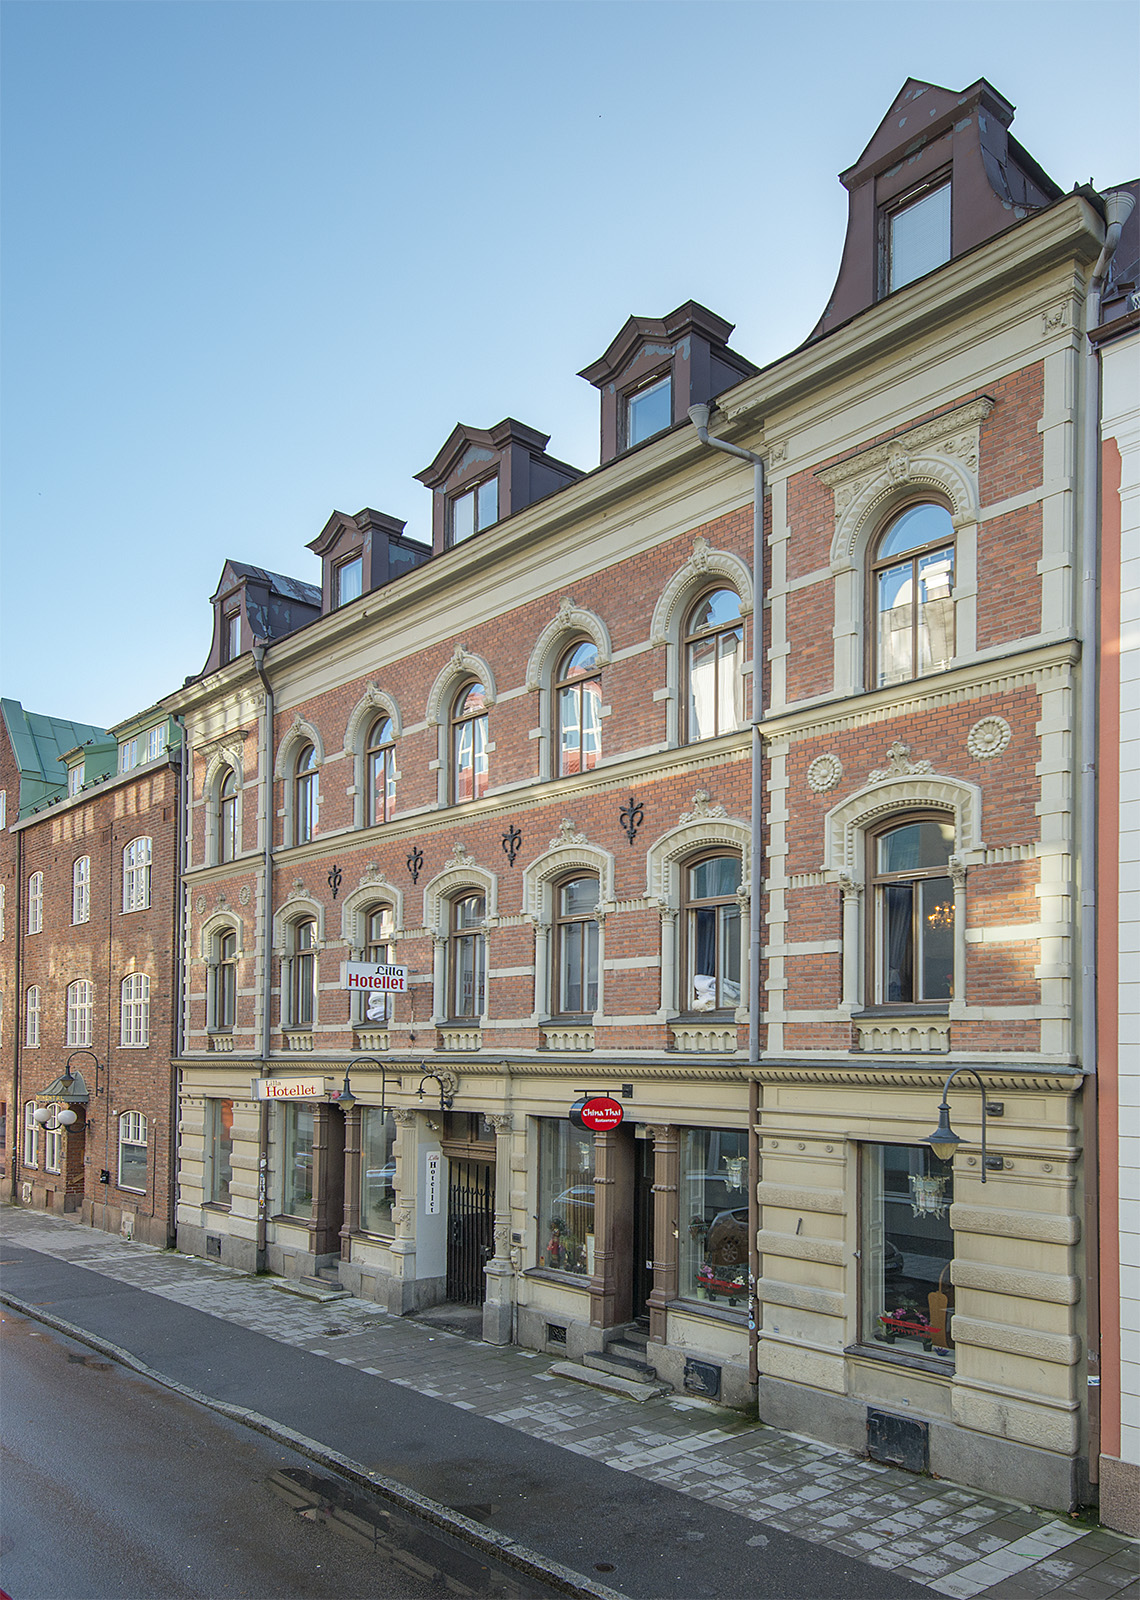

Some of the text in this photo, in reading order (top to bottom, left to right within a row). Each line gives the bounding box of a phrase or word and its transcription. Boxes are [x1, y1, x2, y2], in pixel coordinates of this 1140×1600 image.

[375, 966, 404, 976] Lilla
[349, 974, 404, 990] Hotellet
[266, 1085, 316, 1097] Hotellet
[582, 1108, 620, 1116] China Thai
